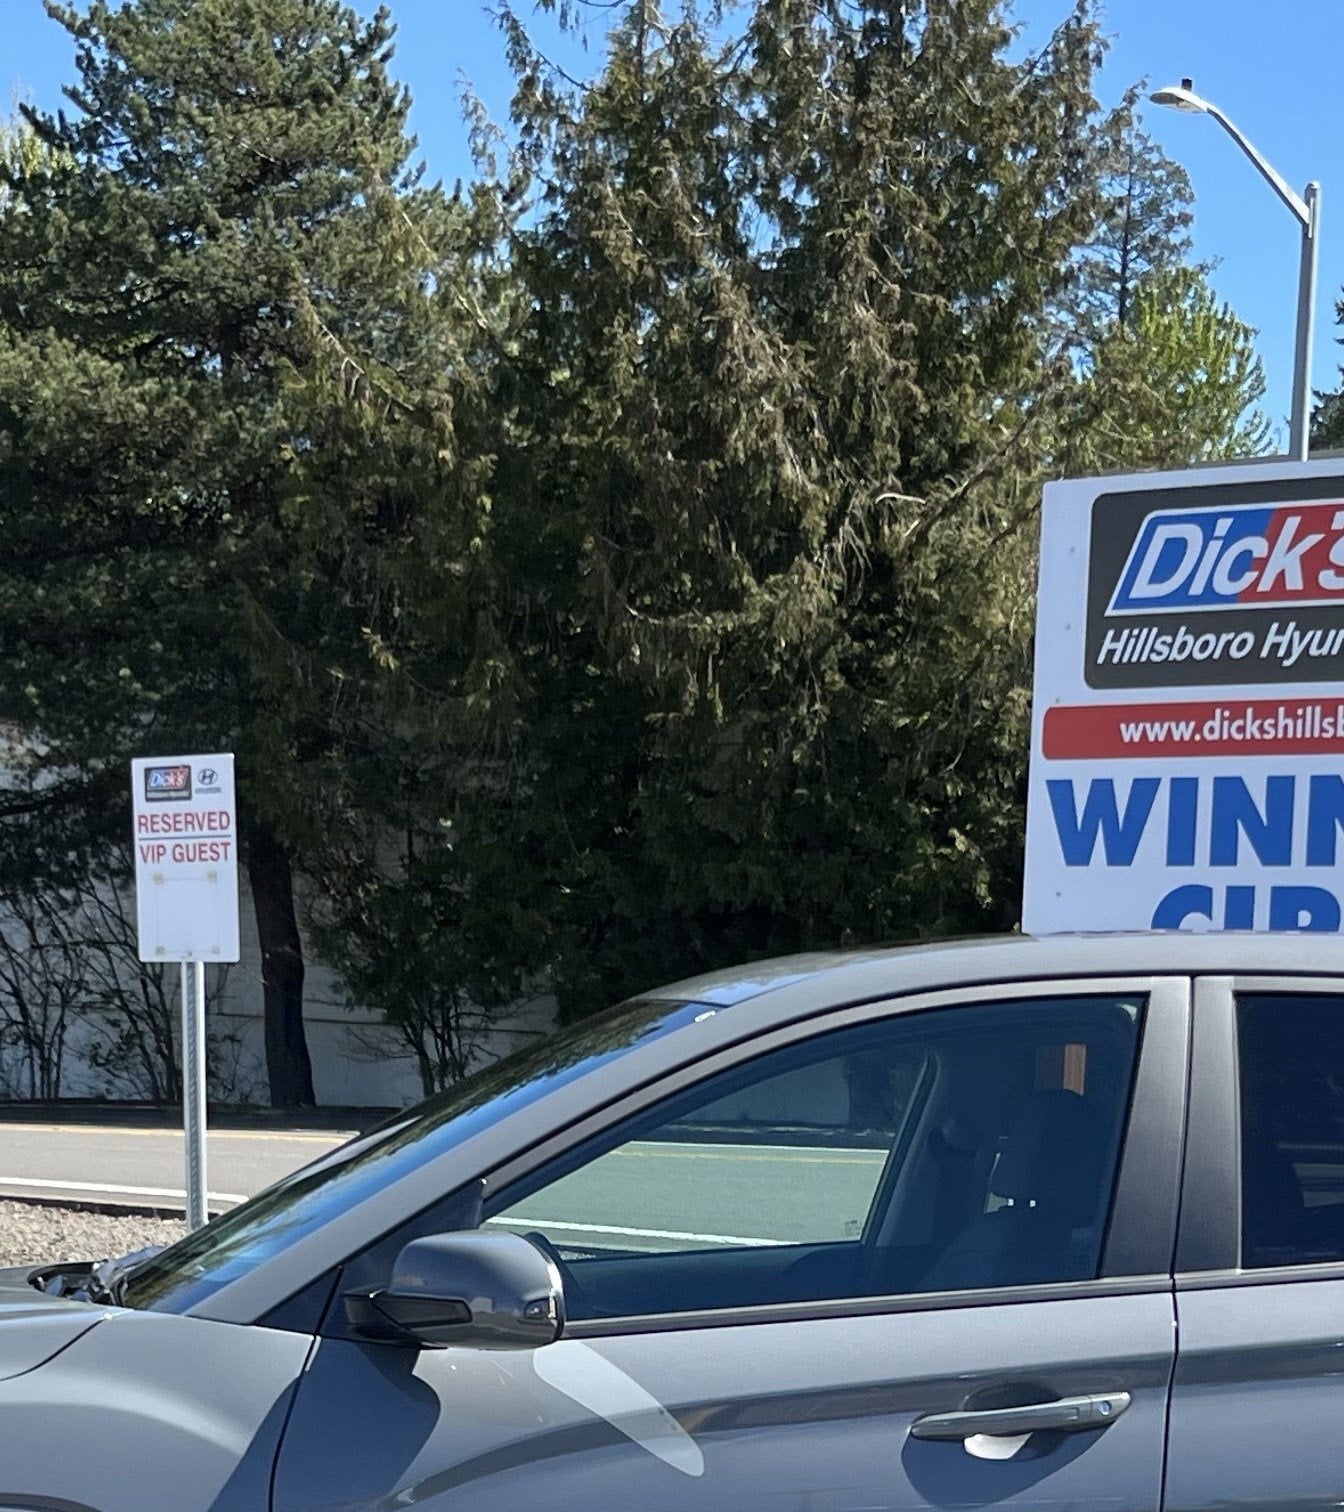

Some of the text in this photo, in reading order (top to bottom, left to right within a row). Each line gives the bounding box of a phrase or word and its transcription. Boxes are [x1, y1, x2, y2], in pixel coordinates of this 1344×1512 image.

[1097, 625, 1255, 664] Hillsboro
[138, 811, 230, 833] RESERVED
[140, 842, 231, 863] VIP GUEST
